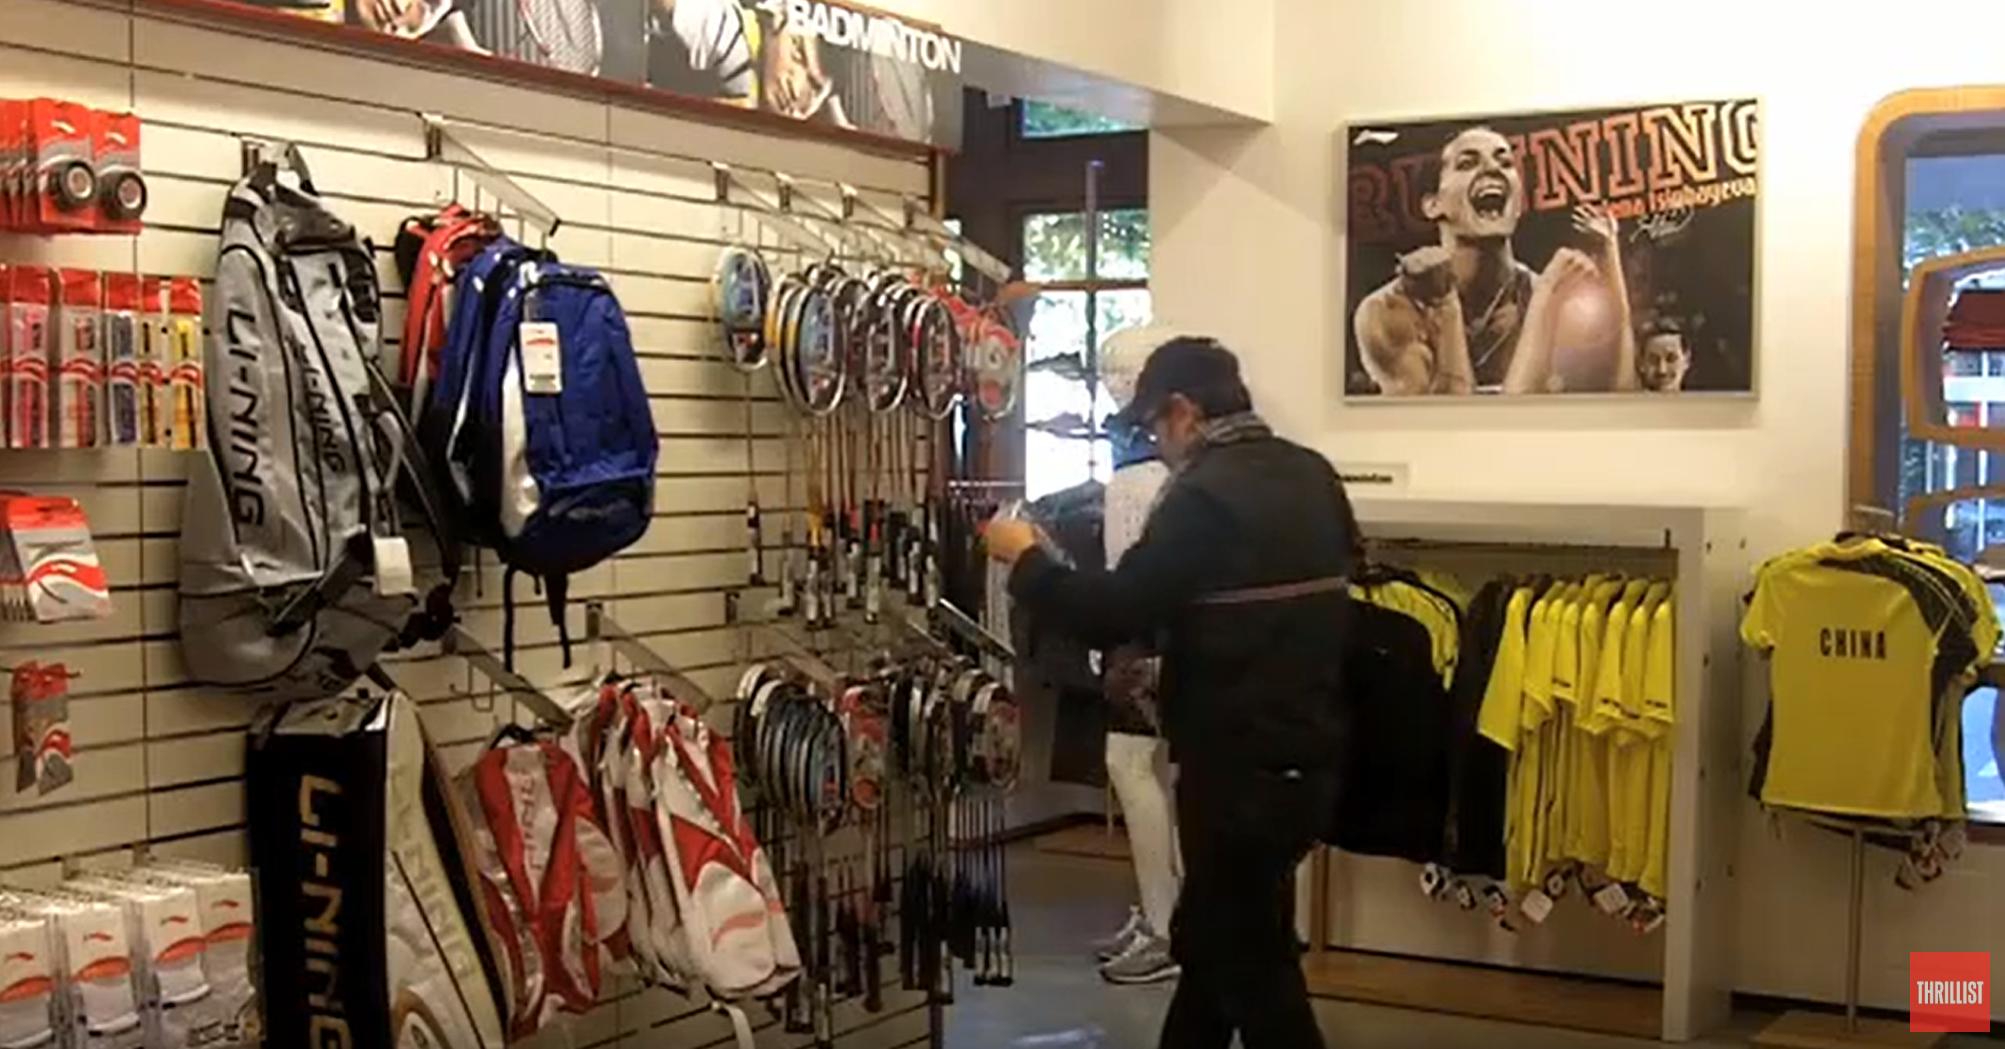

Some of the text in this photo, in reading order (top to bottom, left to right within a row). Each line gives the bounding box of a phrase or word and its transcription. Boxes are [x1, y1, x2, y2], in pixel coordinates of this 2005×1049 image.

[788, 0, 961, 73] BADMINTON
[1349, 101, 1758, 232] RUNING
[227, 308, 264, 526] LI-NING
[1820, 627, 1886, 660] CHINA
